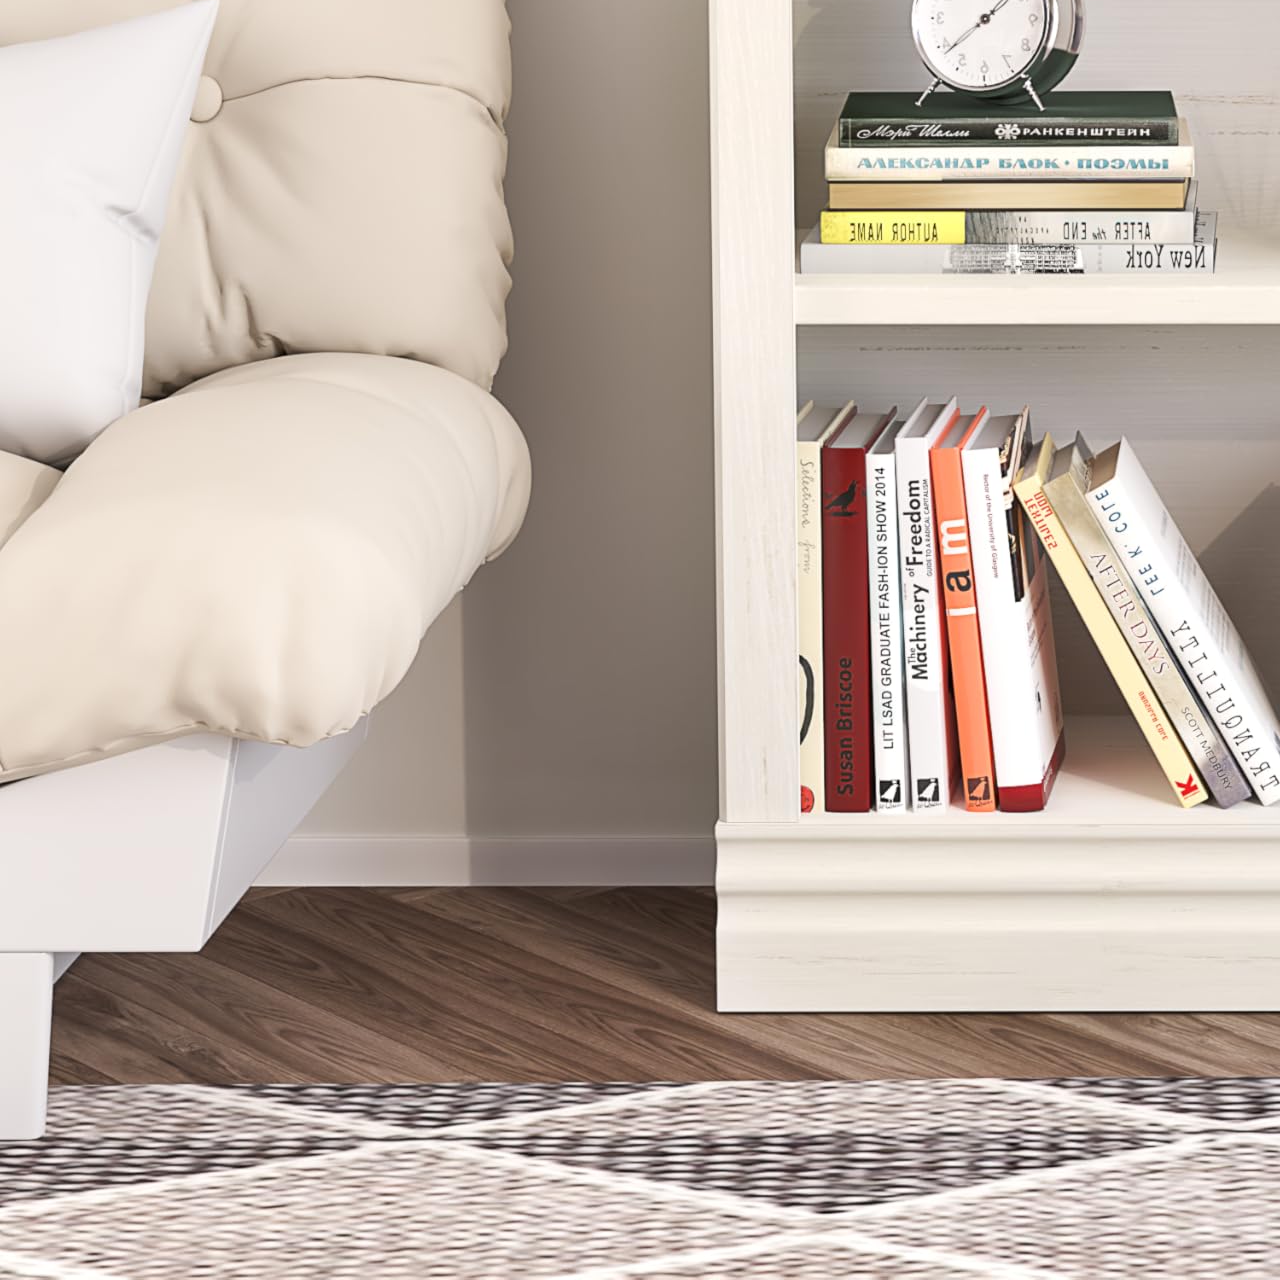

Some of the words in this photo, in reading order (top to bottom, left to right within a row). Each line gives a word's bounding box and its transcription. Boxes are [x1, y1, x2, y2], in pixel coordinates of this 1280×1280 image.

[857, 157, 990, 170] АЛЕКСАНДР
[999, 158, 1060, 170] БЛОК
[1077, 158, 1170, 170] ПОЭМЫ
[874, 467, 886, 498] 2014
[875, 500, 888, 543] SHOW
[903, 480, 923, 566] Freedom
[875, 545, 890, 608] FASH-ION
[903, 567, 915, 577] of
[909, 584, 929, 680] Machinery
[1091, 553, 1136, 619] AFTER
[1130, 620, 1170, 676] DAYS
[879, 611, 892, 687] GRADUATE
[907, 647, 917, 664] The
[834, 657, 853, 732] Briscoe
[881, 691, 893, 726] LSAD
[836, 737, 854, 795] Susan
[883, 729, 894, 750] LIT
[1180, 706, 1205, 738] SCOTT
[1200, 738, 1232, 791] MEDBURY
